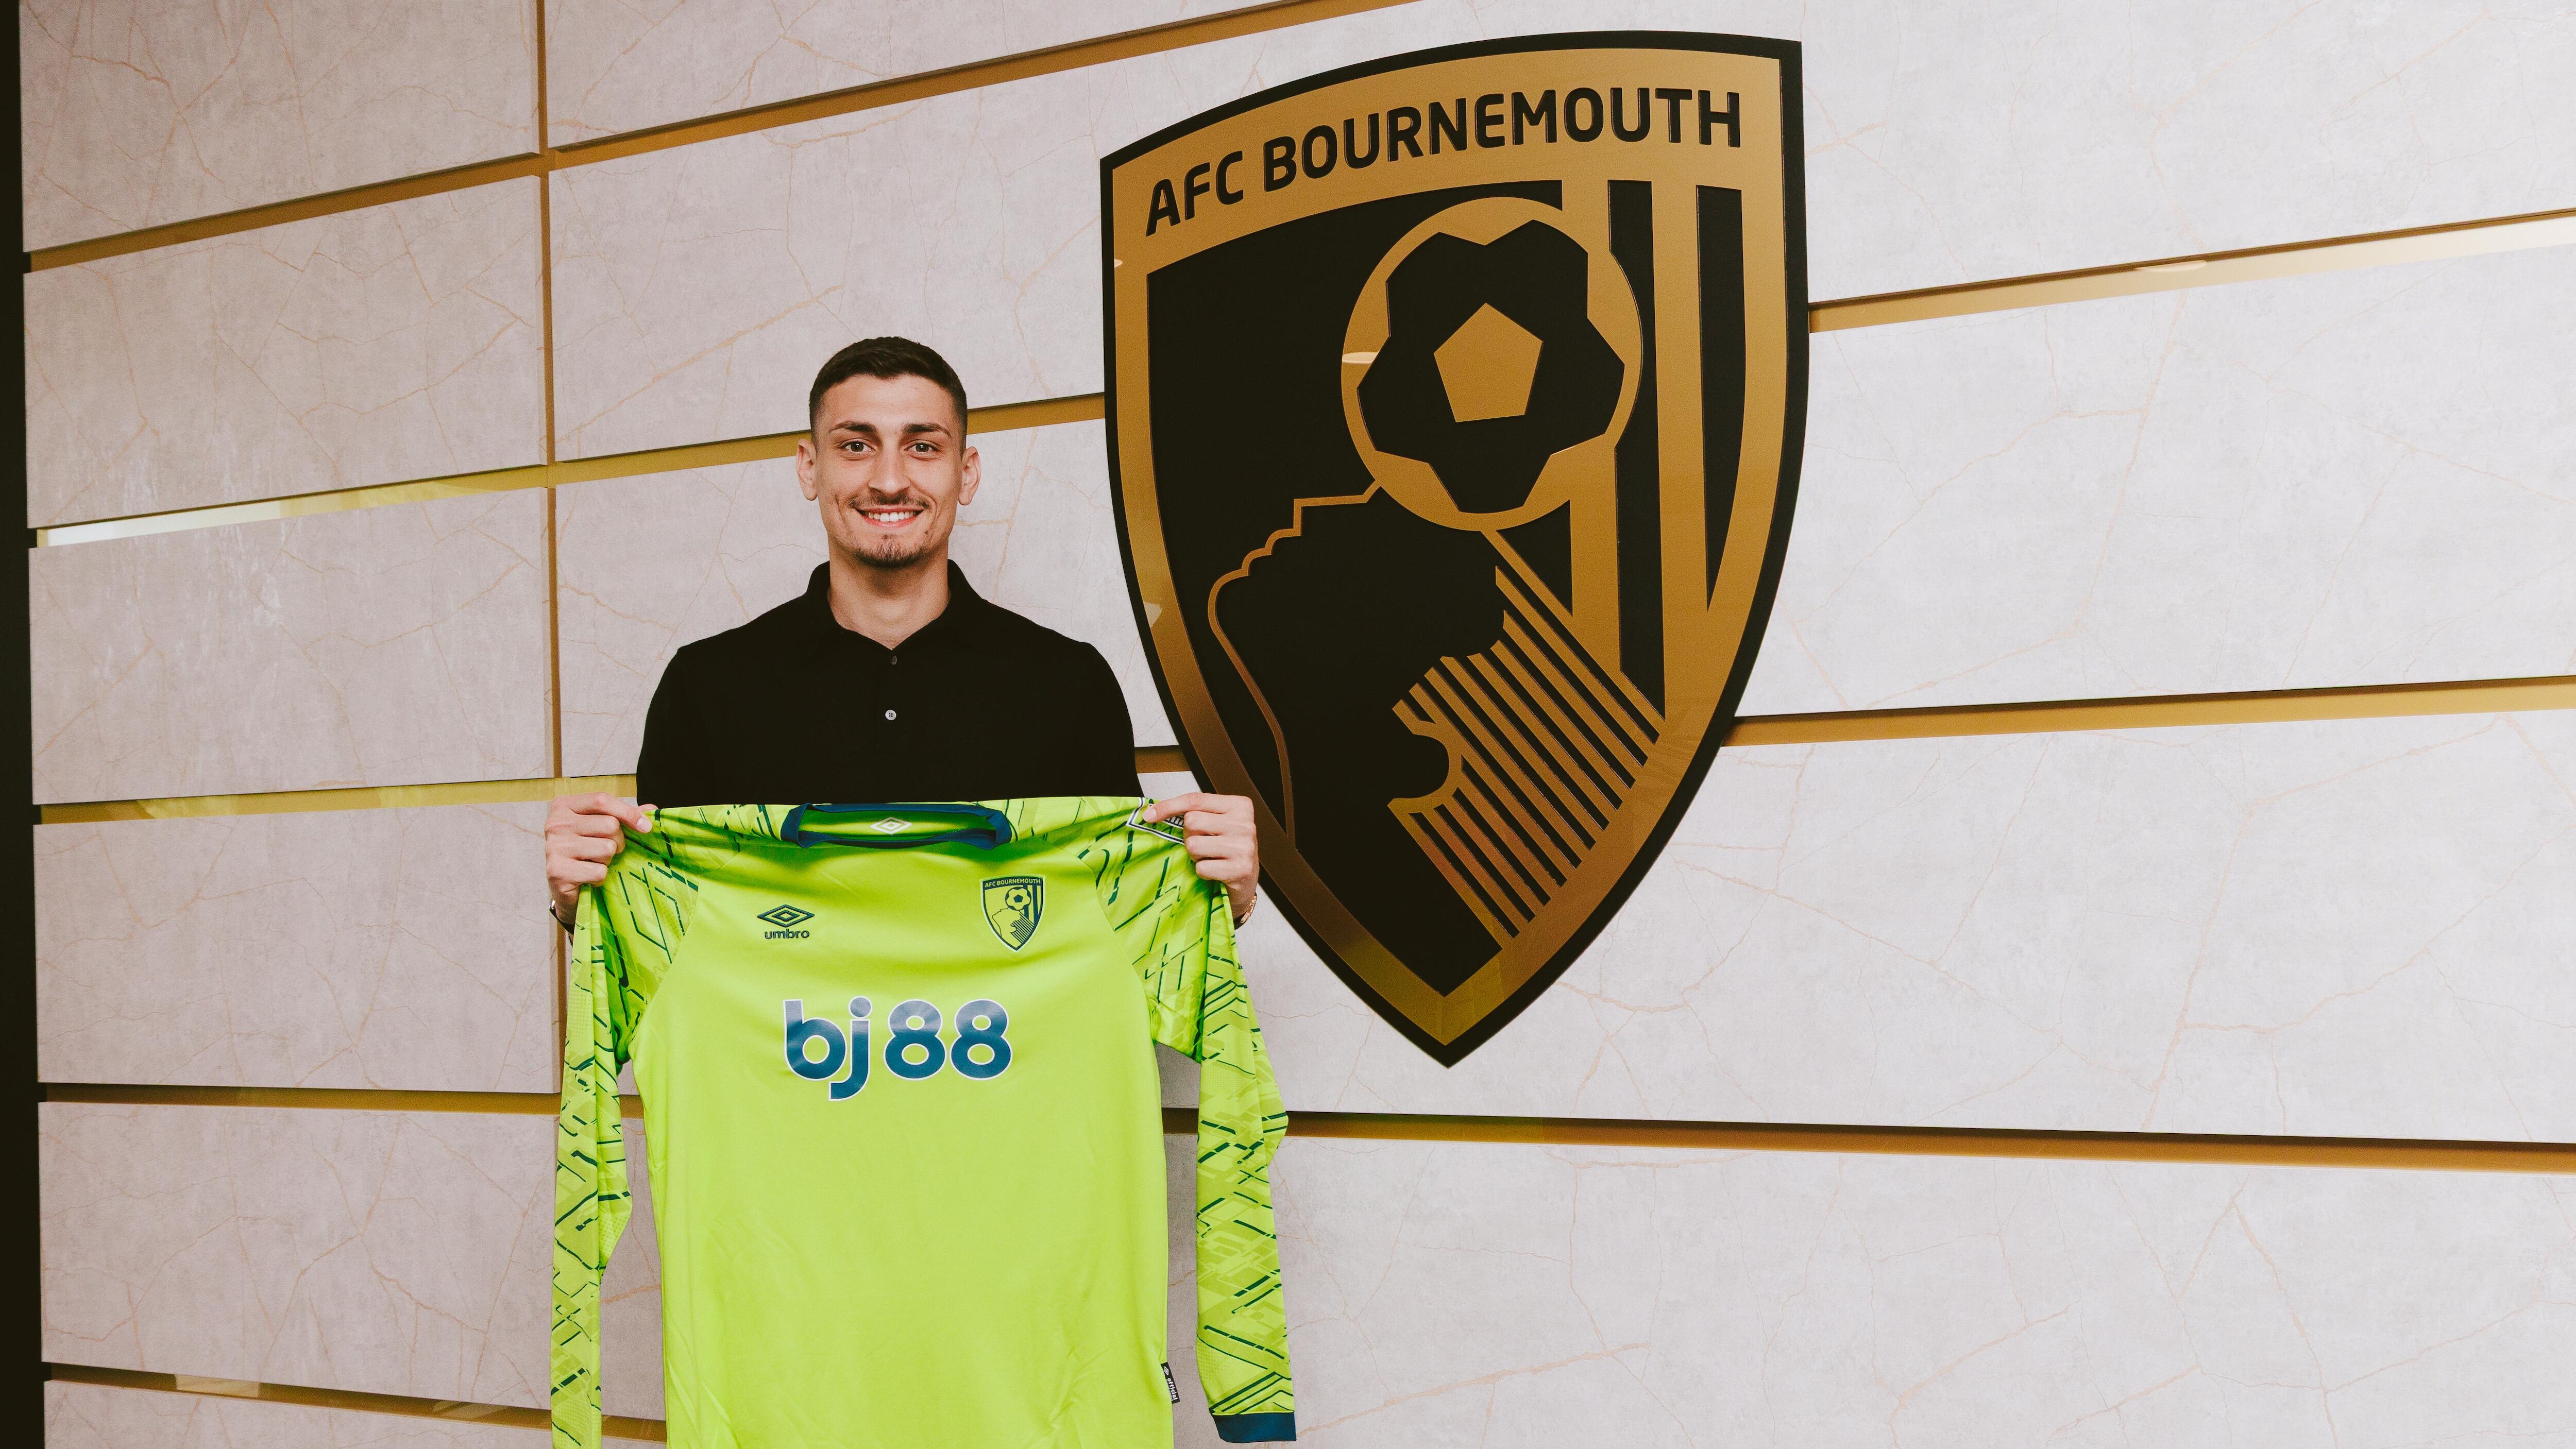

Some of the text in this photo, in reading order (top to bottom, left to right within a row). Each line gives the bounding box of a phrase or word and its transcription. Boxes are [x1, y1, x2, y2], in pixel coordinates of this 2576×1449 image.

[1145, 87, 1741, 237] AFC BOURNEMOUTH
[765, 928, 810, 939] umbro
[1167, 1377, 1178, 1401] official
